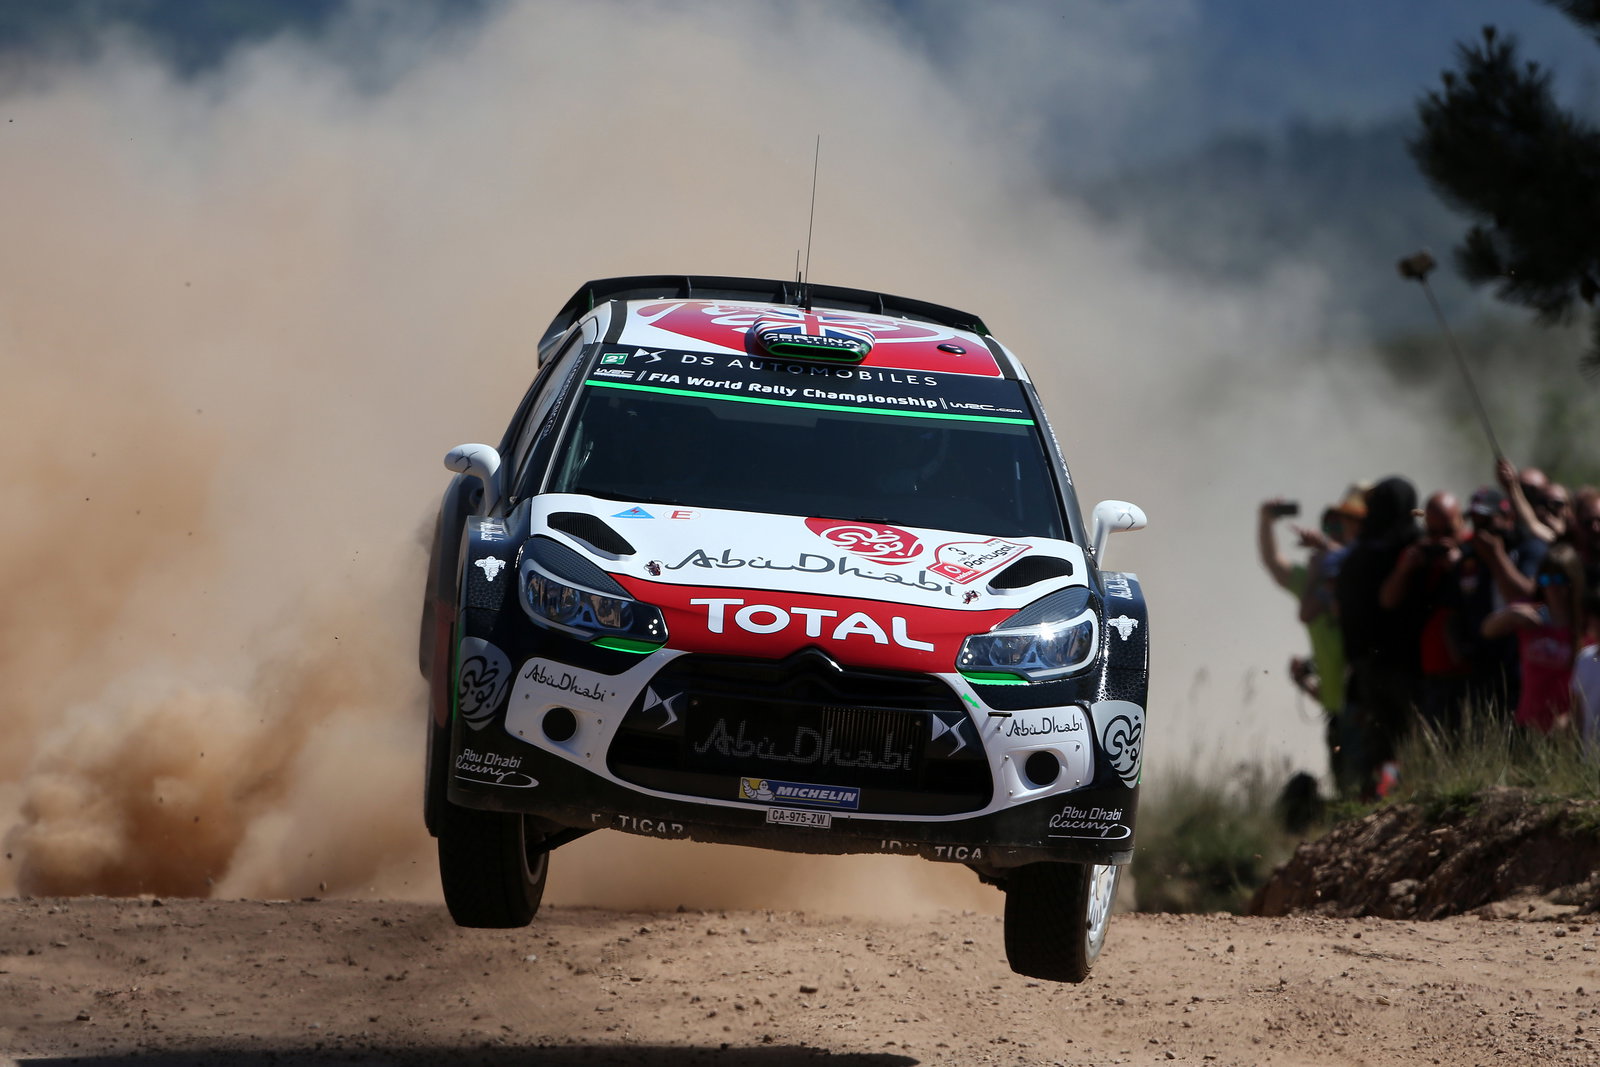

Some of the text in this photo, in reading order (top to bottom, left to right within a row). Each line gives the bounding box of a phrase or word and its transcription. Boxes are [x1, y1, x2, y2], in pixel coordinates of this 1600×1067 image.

[680, 354, 939, 387] DS AUTOMOBILES
[648, 372, 680, 384] FIA
[687, 376, 743, 391] World
[748, 383, 798, 398] Rally
[803, 388, 938, 409] Championship
[797, 552, 957, 597] Dhabi
[690, 598, 935, 653] TOTAL
[561, 672, 607, 702] Dhabi
[1042, 714, 1084, 734] Dhabi
[463, 748, 523, 769] Abu Dhabi
[795, 725, 913, 771] Dhabi
[455, 755, 517, 784] Racing
[776, 786, 858, 802] MICHELIN
[772, 809, 826, 826] CA-975-ZW
[1049, 814, 1118, 838] Racing
[1061, 806, 1123, 821] Abu Dhabi
